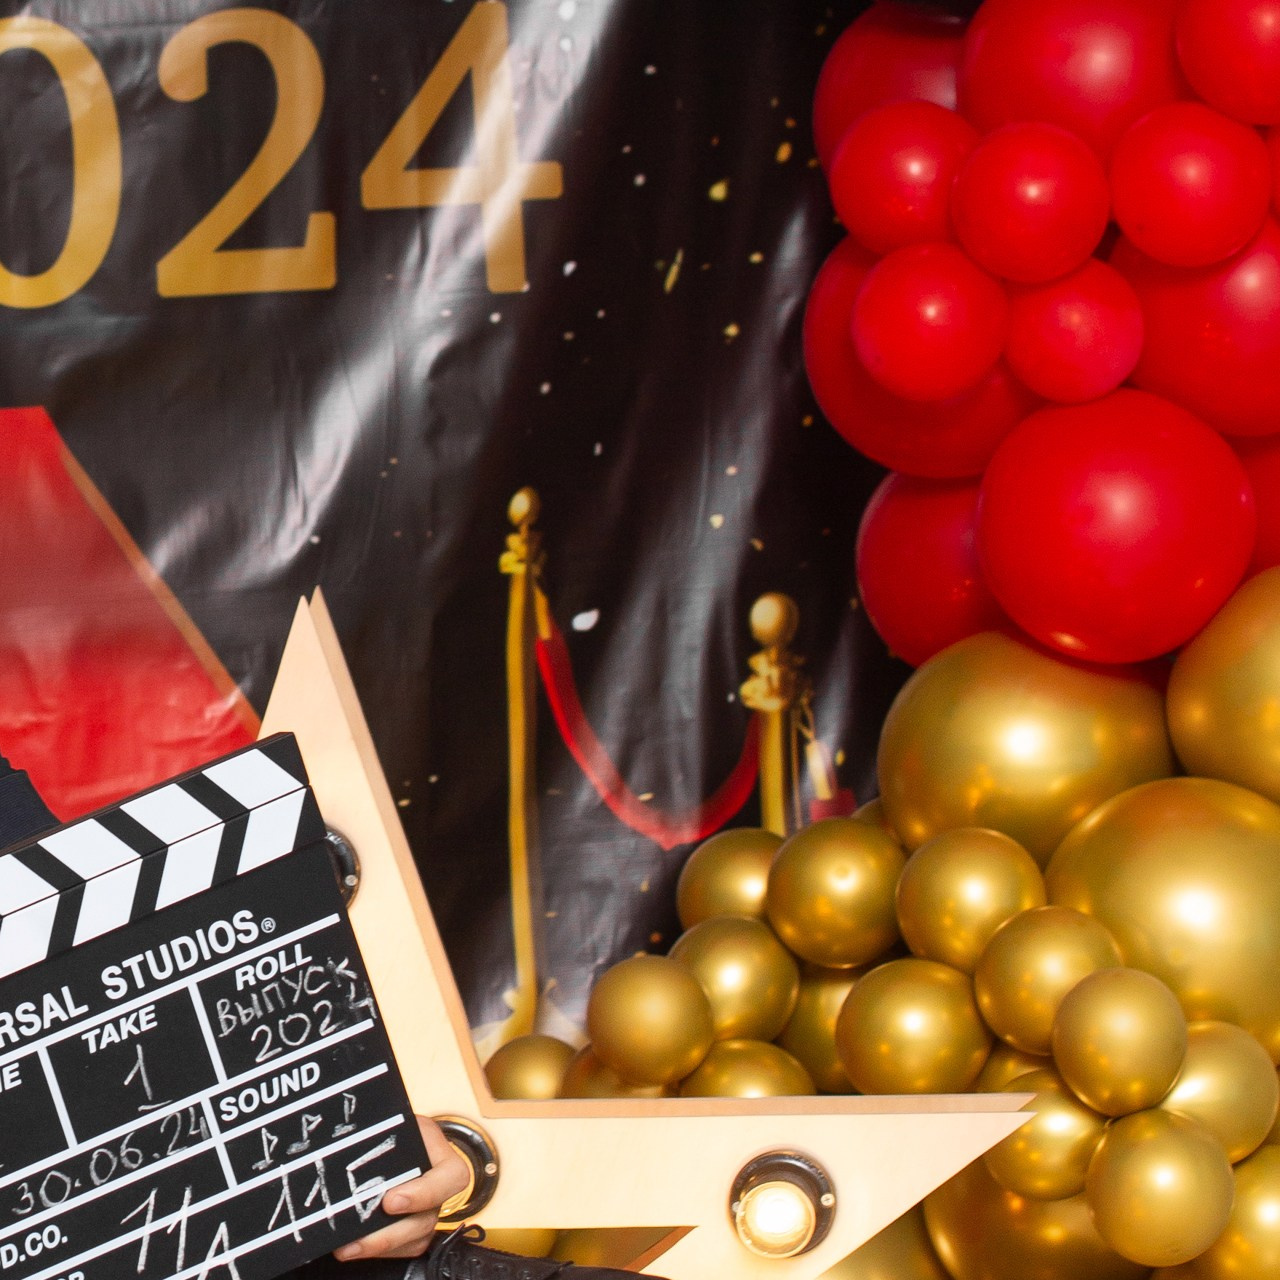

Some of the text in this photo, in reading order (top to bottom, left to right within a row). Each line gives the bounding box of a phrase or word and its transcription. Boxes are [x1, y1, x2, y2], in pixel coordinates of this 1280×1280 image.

[236, 946, 312, 991] ROLL
[81, 1005, 158, 1053] TAKE
[250, 982, 378, 1063] 2024
[123, 1044, 172, 1112] 1
[221, 1062, 321, 1121] SOUND
[11, 1106, 211, 1215] 30.06.24
